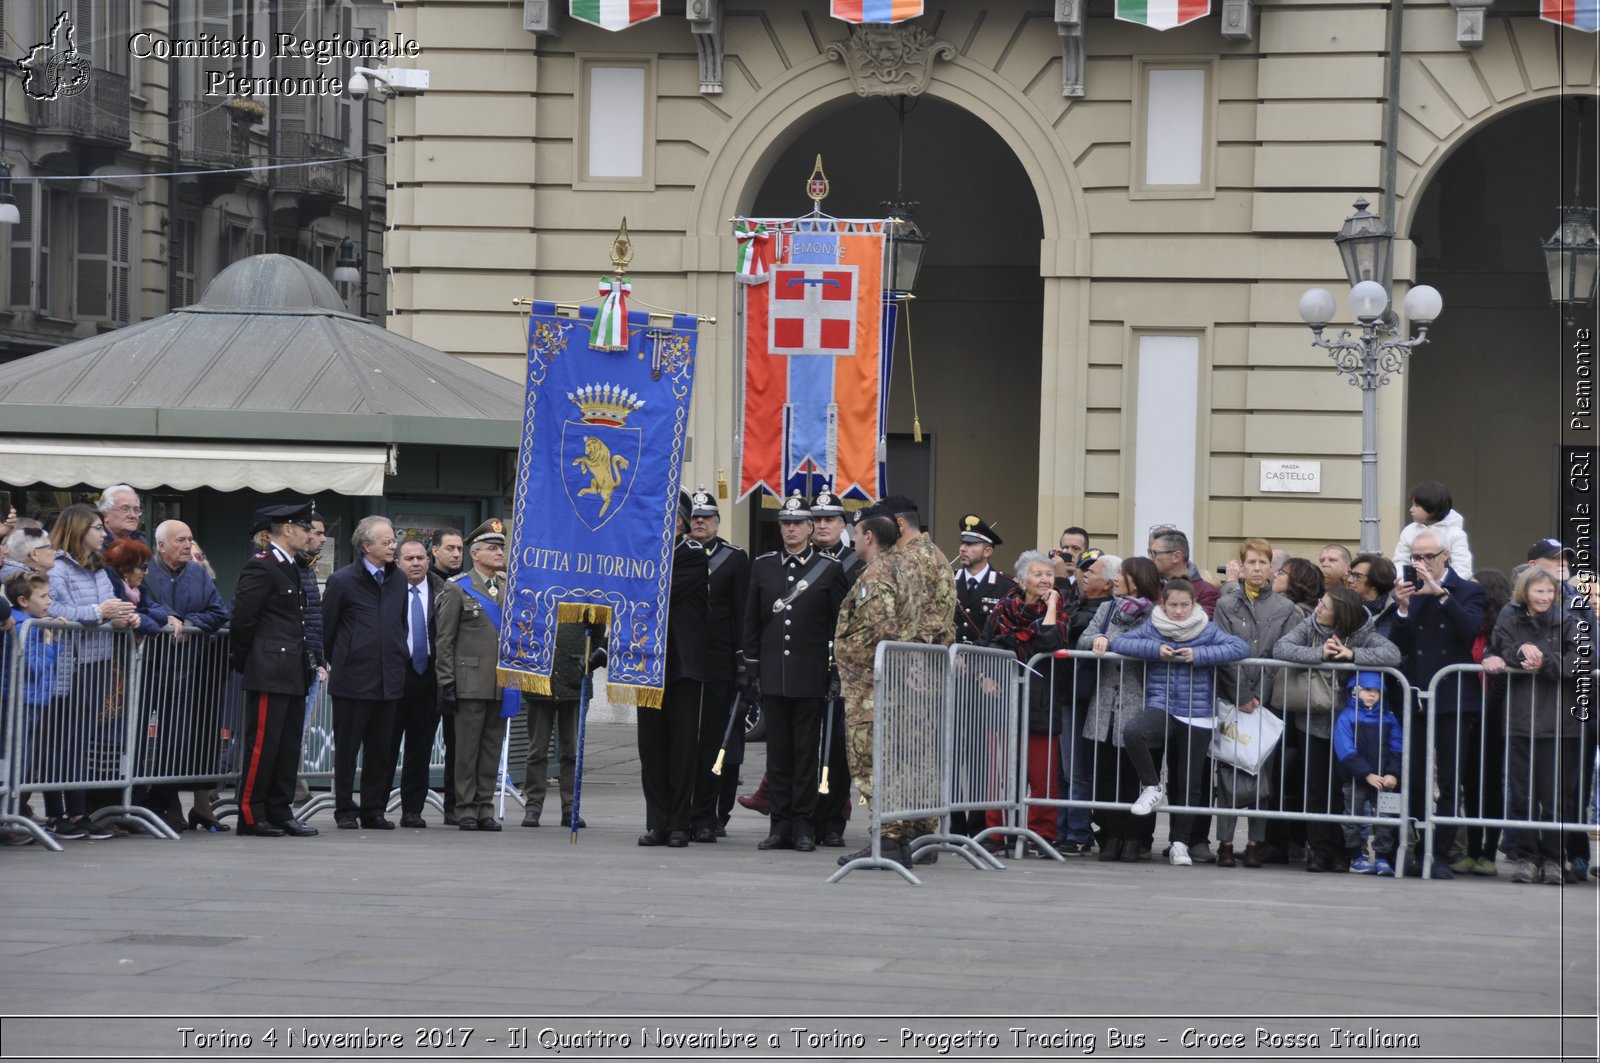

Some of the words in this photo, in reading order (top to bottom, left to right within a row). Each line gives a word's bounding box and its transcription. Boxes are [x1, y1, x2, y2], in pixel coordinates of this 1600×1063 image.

[783, 242, 847, 258] PIEMONTE
[1265, 471, 1315, 481] CASTELLO
[576, 552, 592, 574] DI
[597, 554, 655, 581] TORINO
